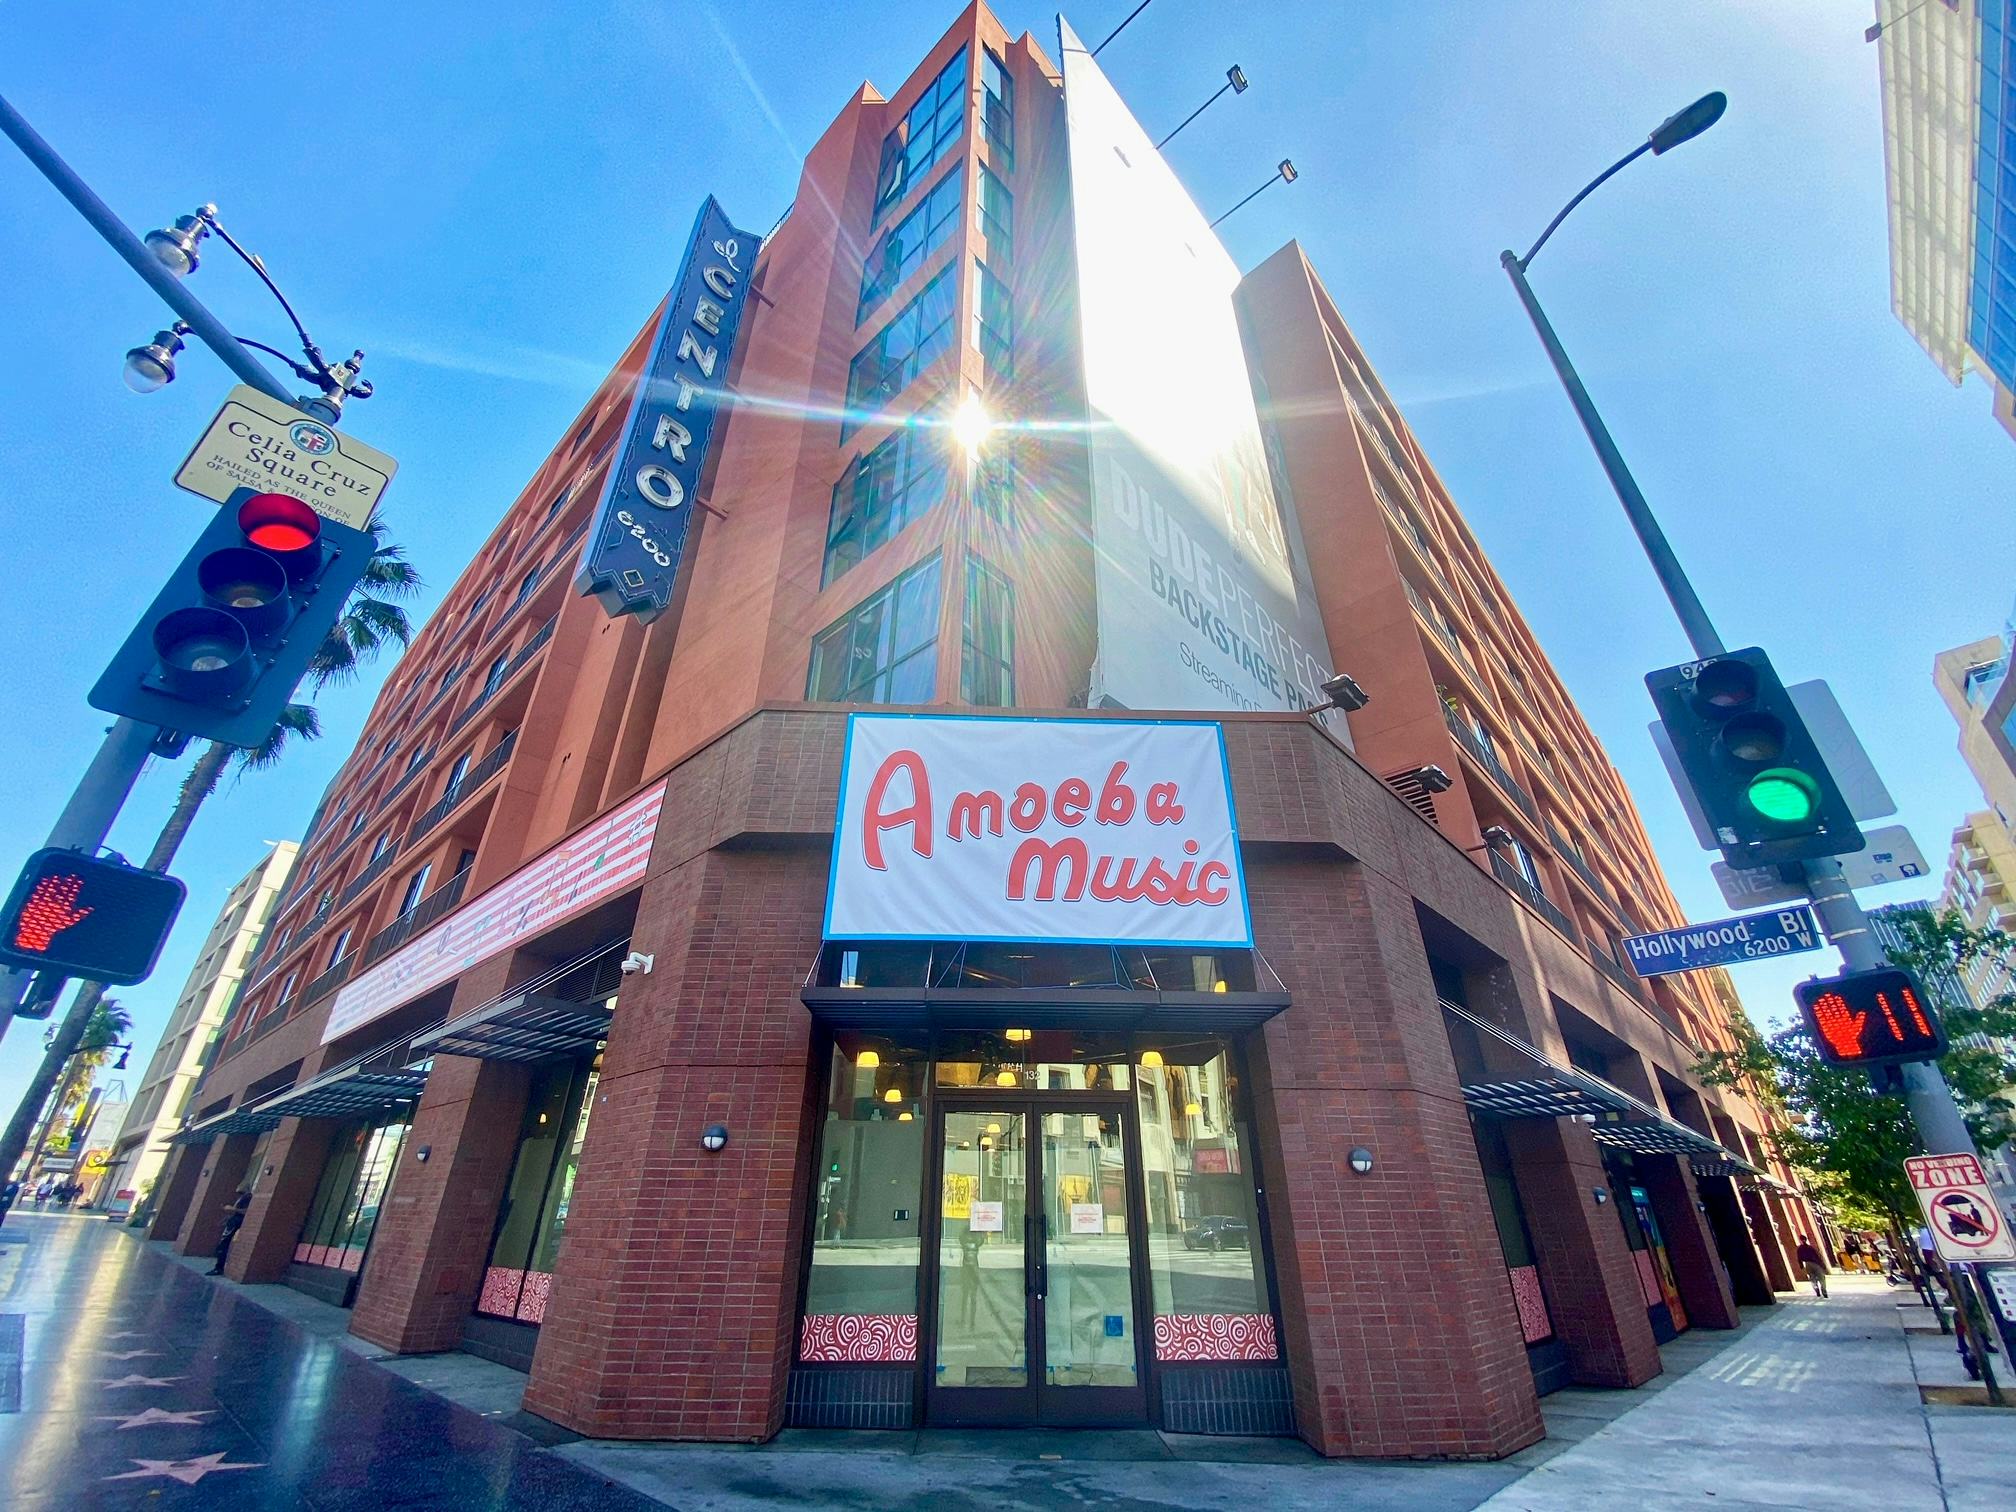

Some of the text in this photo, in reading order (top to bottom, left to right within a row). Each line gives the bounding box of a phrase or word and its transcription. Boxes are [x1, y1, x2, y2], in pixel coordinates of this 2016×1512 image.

[635, 264, 737, 509] CENTRO
[206, 461, 224, 473] OF
[226, 470, 263, 490] SALSA
[228, 421, 371, 496] Celia Cruz
[246, 447, 337, 497] Square
[213, 455, 351, 518] HAILED AS THE QUEEN
[617, 510, 671, 567] 6200
[1109, 455, 1338, 720] DUDE PERFECT
[1150, 556, 1281, 701] BACKSTAGE
[1682, 660, 1717, 678] 94
[861, 748, 1186, 872] Amoeba
[1630, 910, 1808, 960] Hollywood Bl
[1744, 932, 1812, 957] 6200 W
[1876, 987, 1932, 1041] 11
[1024, 1070, 1041, 1080] 132
[1908, 1160, 1925, 1170] NO
[1912, 1167, 1982, 1188] ZONE
